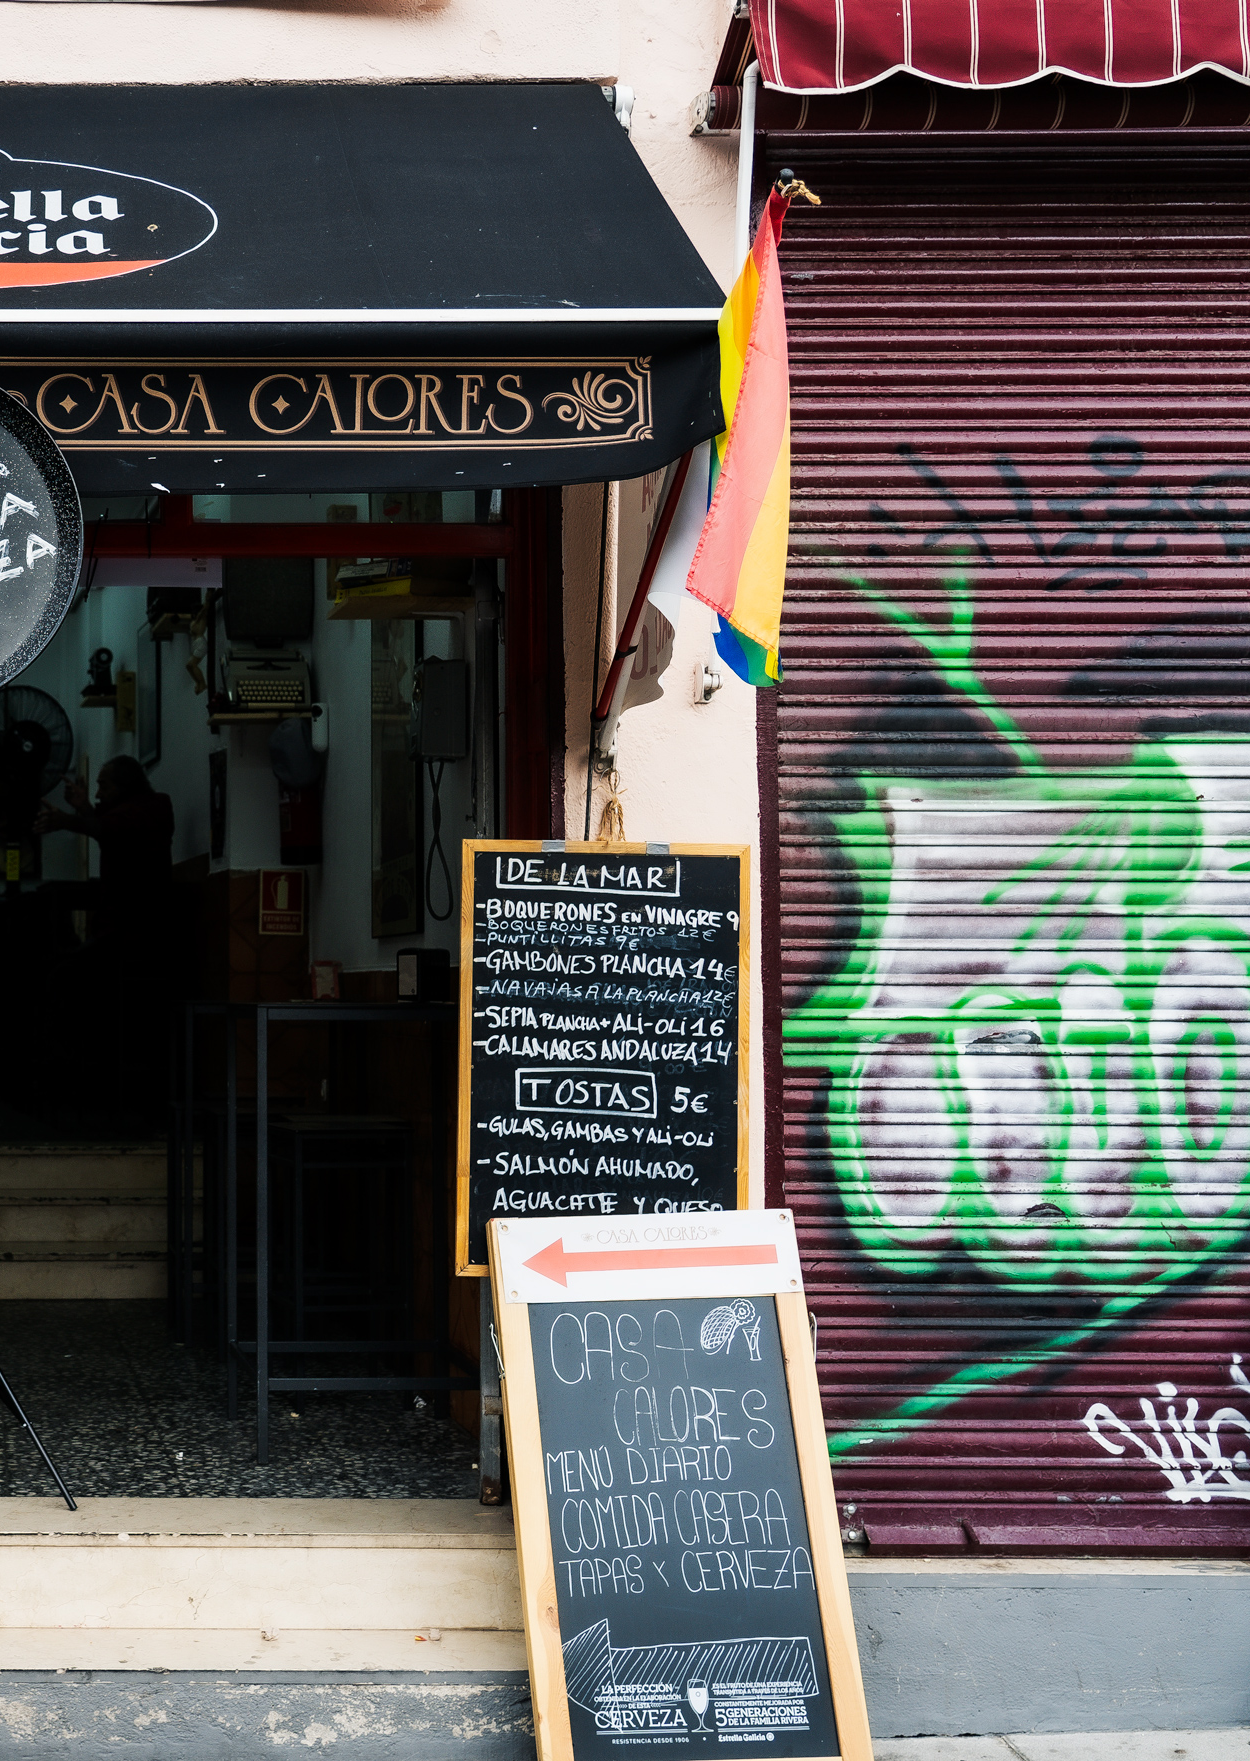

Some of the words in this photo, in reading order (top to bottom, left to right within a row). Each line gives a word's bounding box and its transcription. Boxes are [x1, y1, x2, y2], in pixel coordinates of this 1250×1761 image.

[36, 373, 225, 435] CASA
[249, 373, 535, 435] CALORES
[506, 857, 544, 882] DE
[557, 863, 589, 889] LA
[600, 865, 666, 889] MAR
[486, 898, 616, 924] BOQUERONES
[644, 904, 722, 928] VINAGRE
[486, 919, 608, 935] BOQUERONES
[610, 923, 666, 936] FRITOS
[485, 949, 596, 975] GAMBONES
[600, 952, 686, 979] PLANCHA
[624, 987, 700, 1003] PLANCHA
[483, 1034, 596, 1061] CALAMARES
[600, 1039, 698, 1065] ANDALUZA
[698, 1040, 732, 1065] 14
[521, 1077, 650, 1111] TOSTAS
[669, 1085, 708, 1113] 5€
[550, 1120, 629, 1144] GAMBAS
[631, 1126, 644, 1143] Y
[492, 1148, 588, 1176] SALMÓN
[593, 1156, 698, 1186] AHUMADO,
[491, 1187, 618, 1214] AGUACATE
[632, 1196, 645, 1213] Y
[653, 1197, 724, 1213] QUESO
[596, 1229, 639, 1244] CASA
[643, 1226, 708, 1242] CALORES
[550, 1309, 694, 1384] CASA
[613, 1385, 775, 1449] CALORES
[546, 1445, 613, 1495] MENÚ
[626, 1445, 732, 1485] DIARIO
[561, 1491, 669, 1553] COMIDA
[673, 1488, 791, 1546] CASERA
[558, 1553, 644, 1598] TAPAS
[681, 1546, 817, 1593] CERVEZA
[615, 1682, 673, 1694] PERFECCIÓN
[594, 1708, 688, 1729] CERVEZA
[714, 1708, 728, 1727] 5
[725, 1706, 807, 1718] GENERACIONES
[718, 1734, 743, 1742] Estrella
[743, 1733, 766, 1742] Galicia
